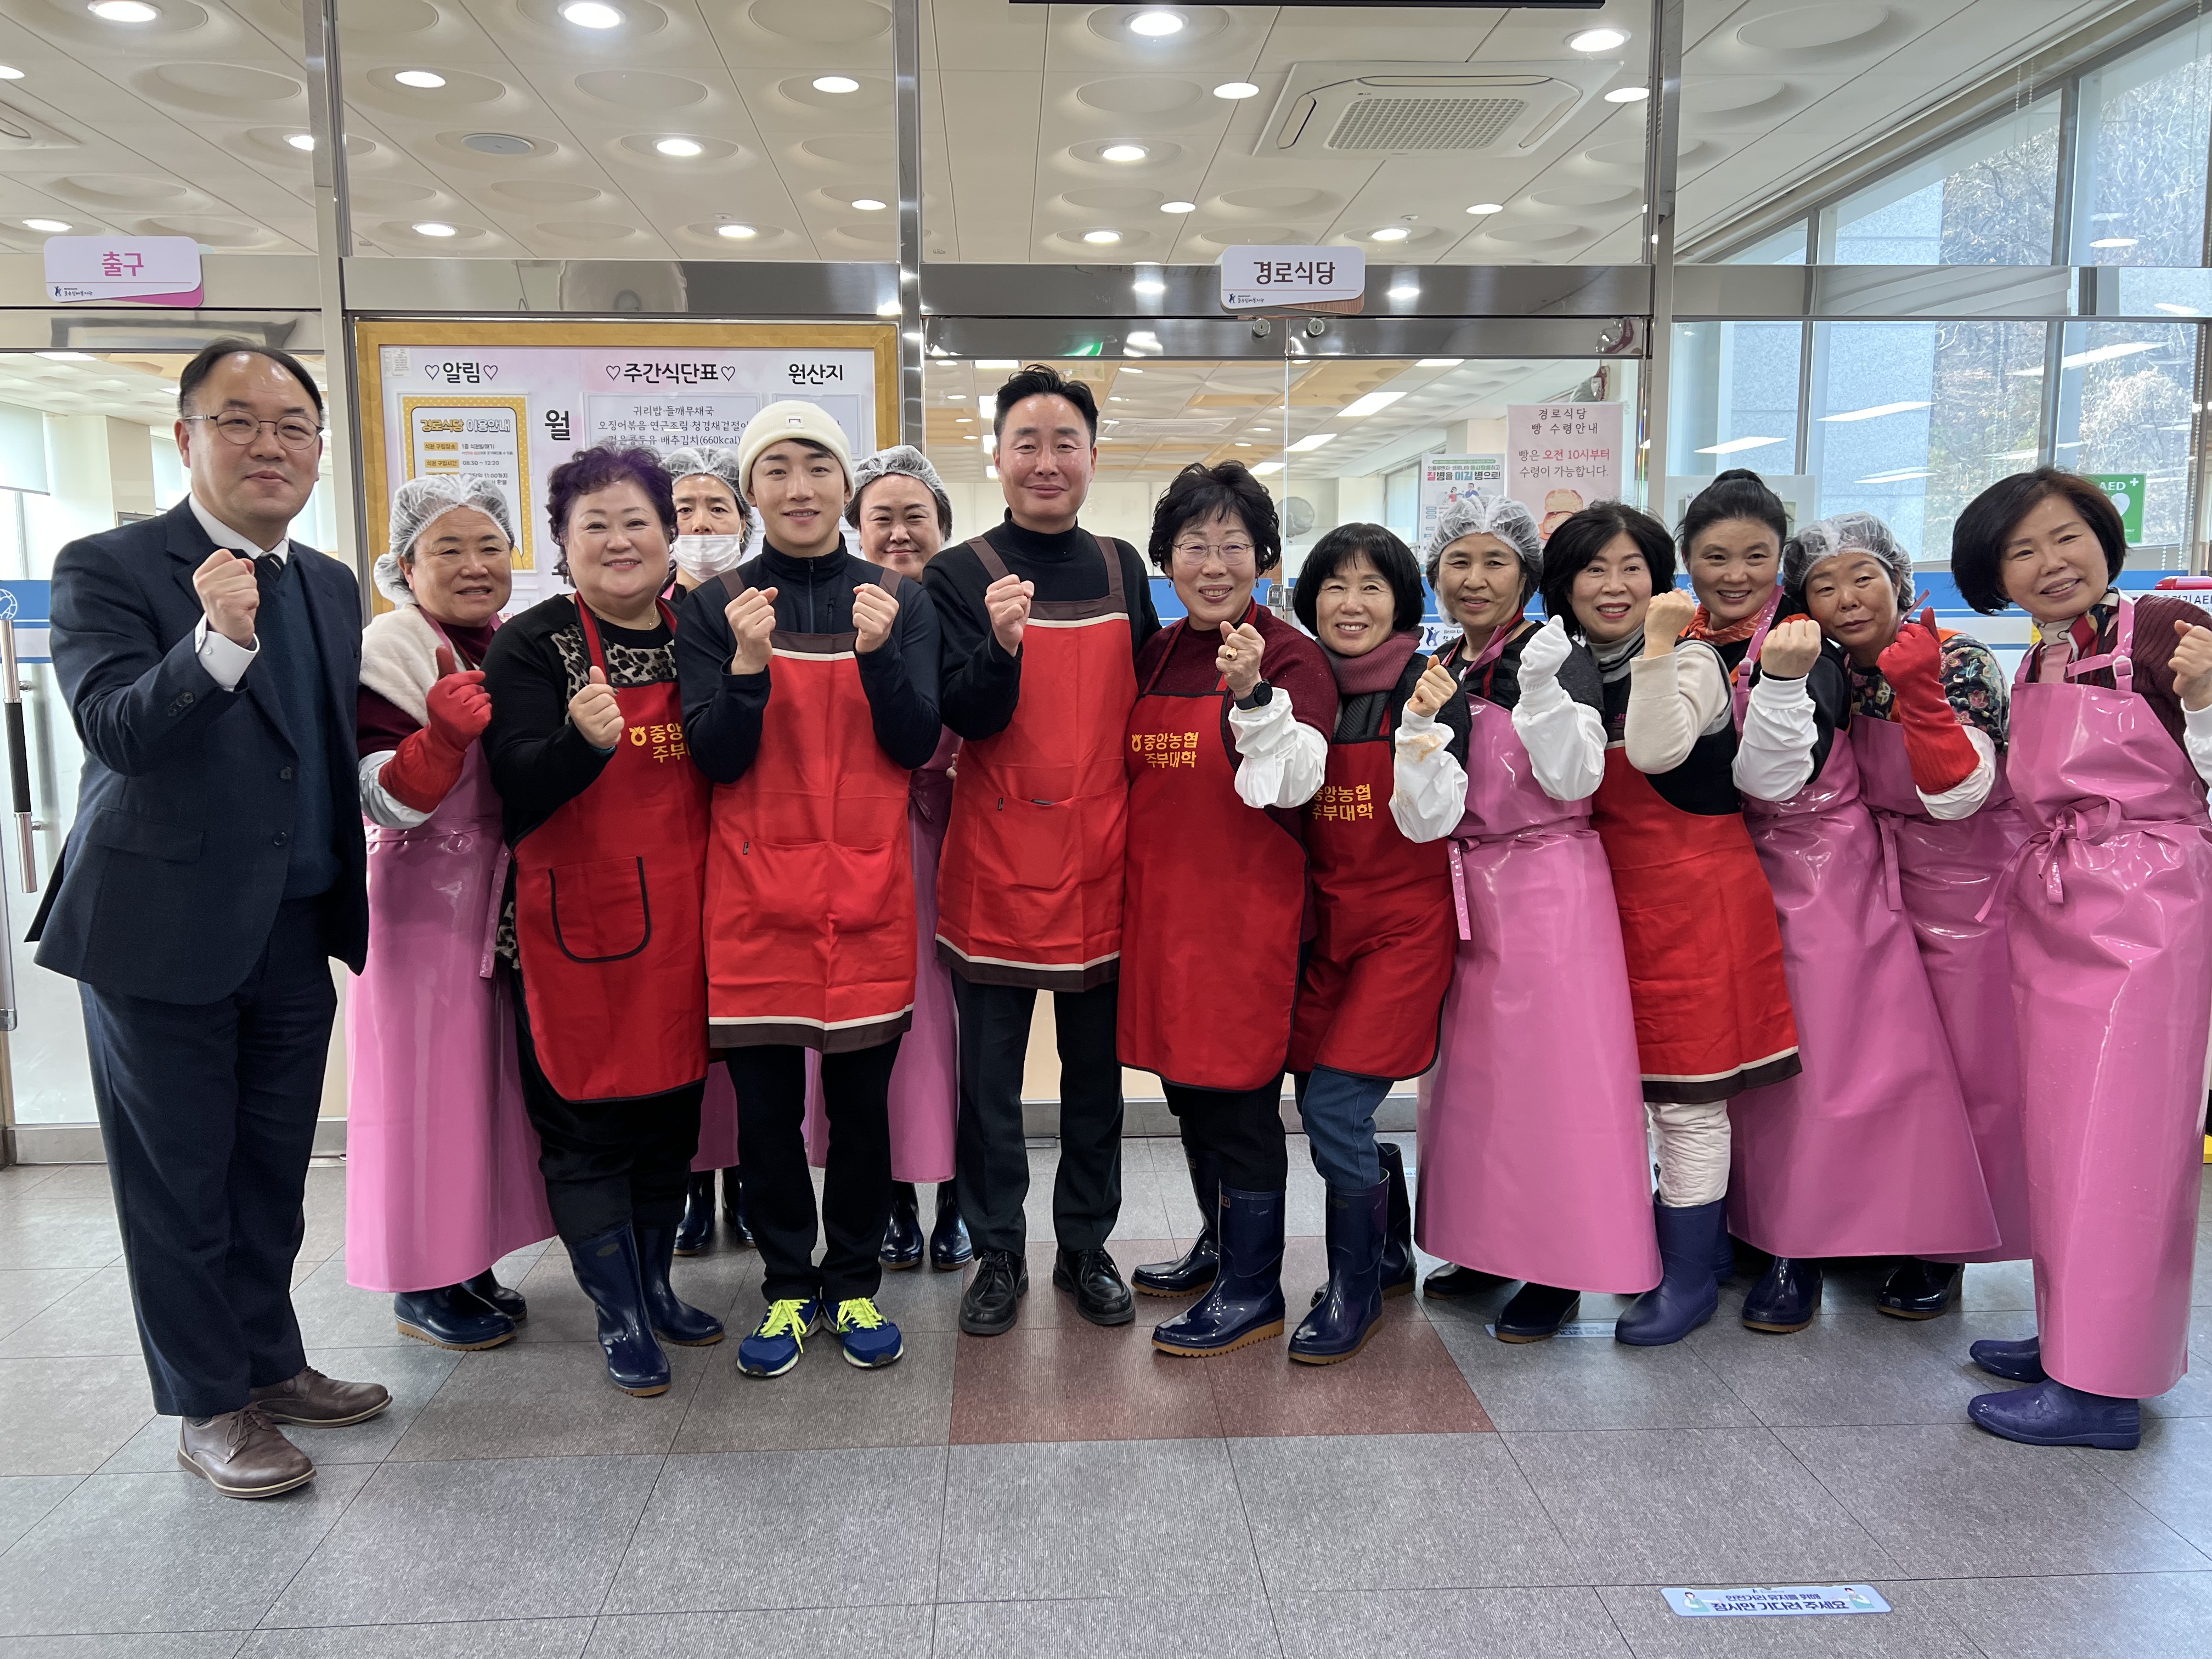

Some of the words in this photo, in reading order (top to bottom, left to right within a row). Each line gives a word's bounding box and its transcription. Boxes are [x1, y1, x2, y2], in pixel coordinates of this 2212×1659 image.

[101, 251, 144, 276] 출구
[1254, 261, 1335, 285] 경로식당
[443, 362, 480, 383] 알림
[623, 363, 719, 383] 주간식단표
[788, 363, 844, 385] 원산지
[1538, 408, 1587, 420] 경로식당
[420, 419, 464, 432] 경로식당
[466, 419, 510, 432] 이용안내
[545, 410, 570, 441] 월
[1531, 423, 1542, 435] 빵
[1549, 422, 1598, 435] 수령안내
[1519, 449, 1540, 461] 빵은
[1542, 449, 1564, 461] 오전
[1568, 448, 1610, 461] 10시부터
[1427, 471, 1453, 481] 질병을
[1519, 466, 1550, 478] 수령이
[1554, 465, 1609, 478] 가능합니다.
[2099, 482, 2126, 490] AED
[2194, 595, 2212, 605] AE
[1144, 732, 1199, 751] 중앙농협
[653, 742, 691, 763] 주부
[1144, 751, 1197, 769] 주부대학
[1312, 802, 1374, 821] 주부대학
[1711, 1602, 1756, 1611] 잠시만
[1759, 1601, 1803, 1611] 기다려
[1804, 1600, 1849, 1610] 주세요
